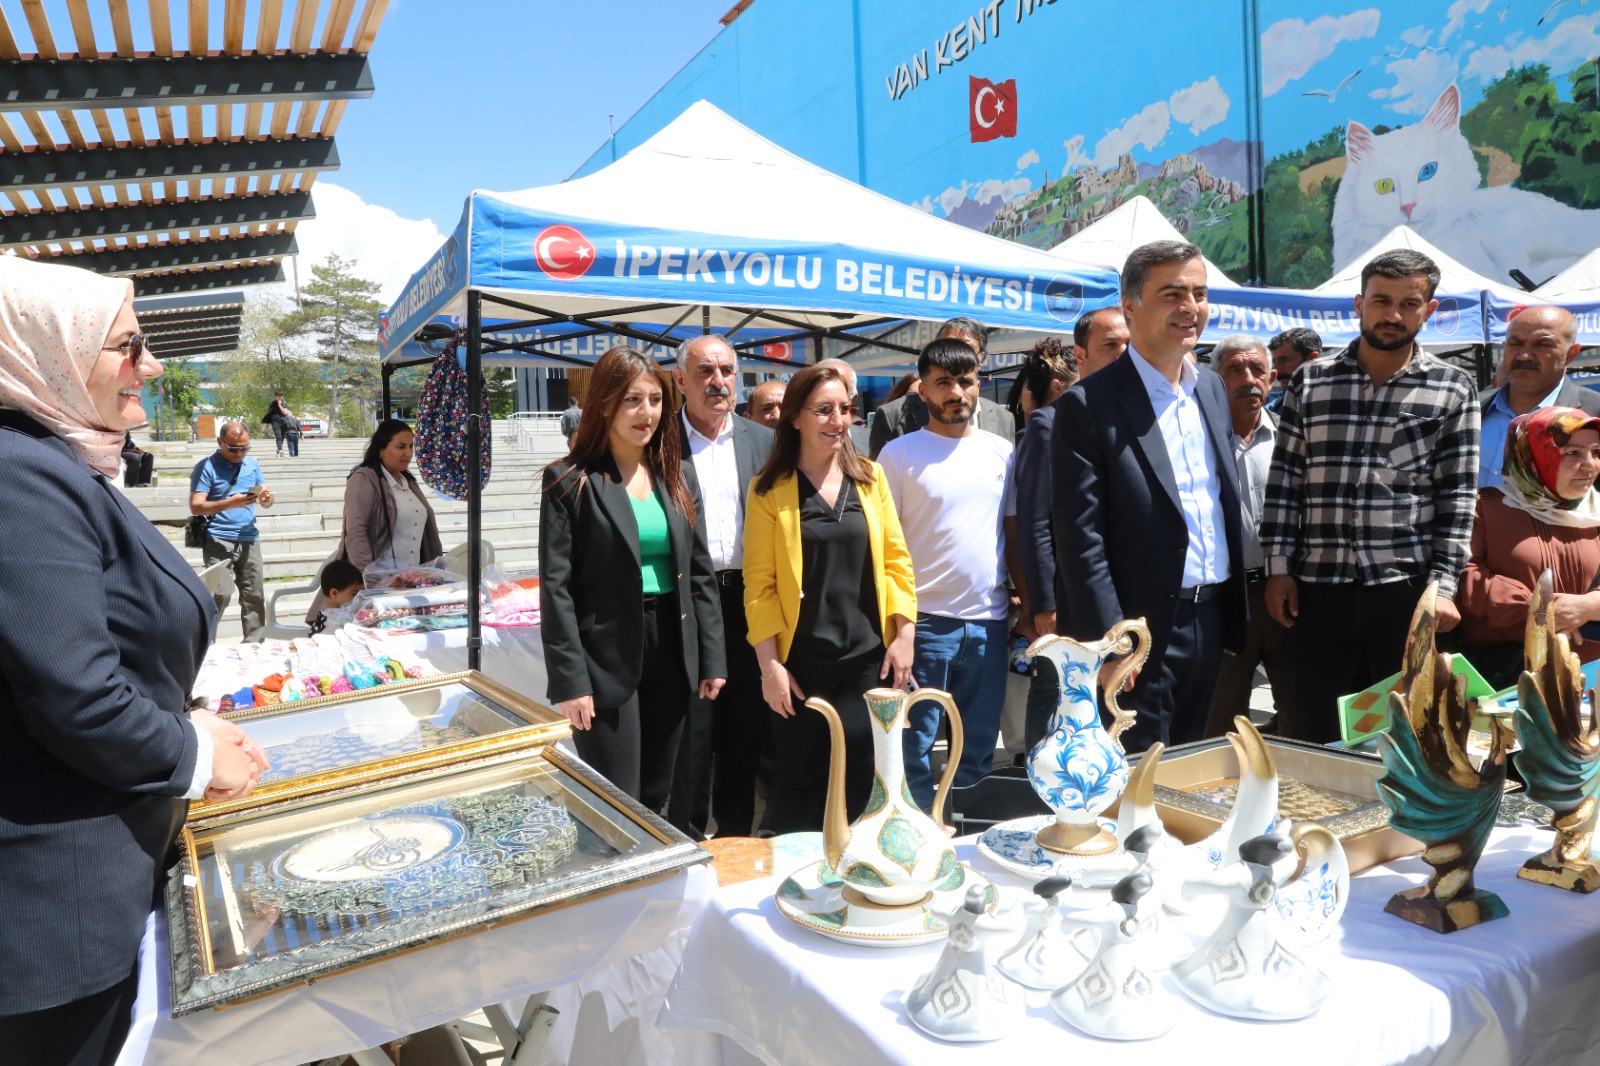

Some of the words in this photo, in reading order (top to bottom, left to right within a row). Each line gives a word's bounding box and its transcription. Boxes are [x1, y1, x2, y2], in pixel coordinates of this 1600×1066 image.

[885, 48, 929, 101] VAN
[935, 0, 1004, 74] KENT
[613, 239, 822, 290] İPEKYOLU
[836, 259, 1035, 312] BELEDİYESİ
[1206, 303, 1305, 331] PEKYOLU
